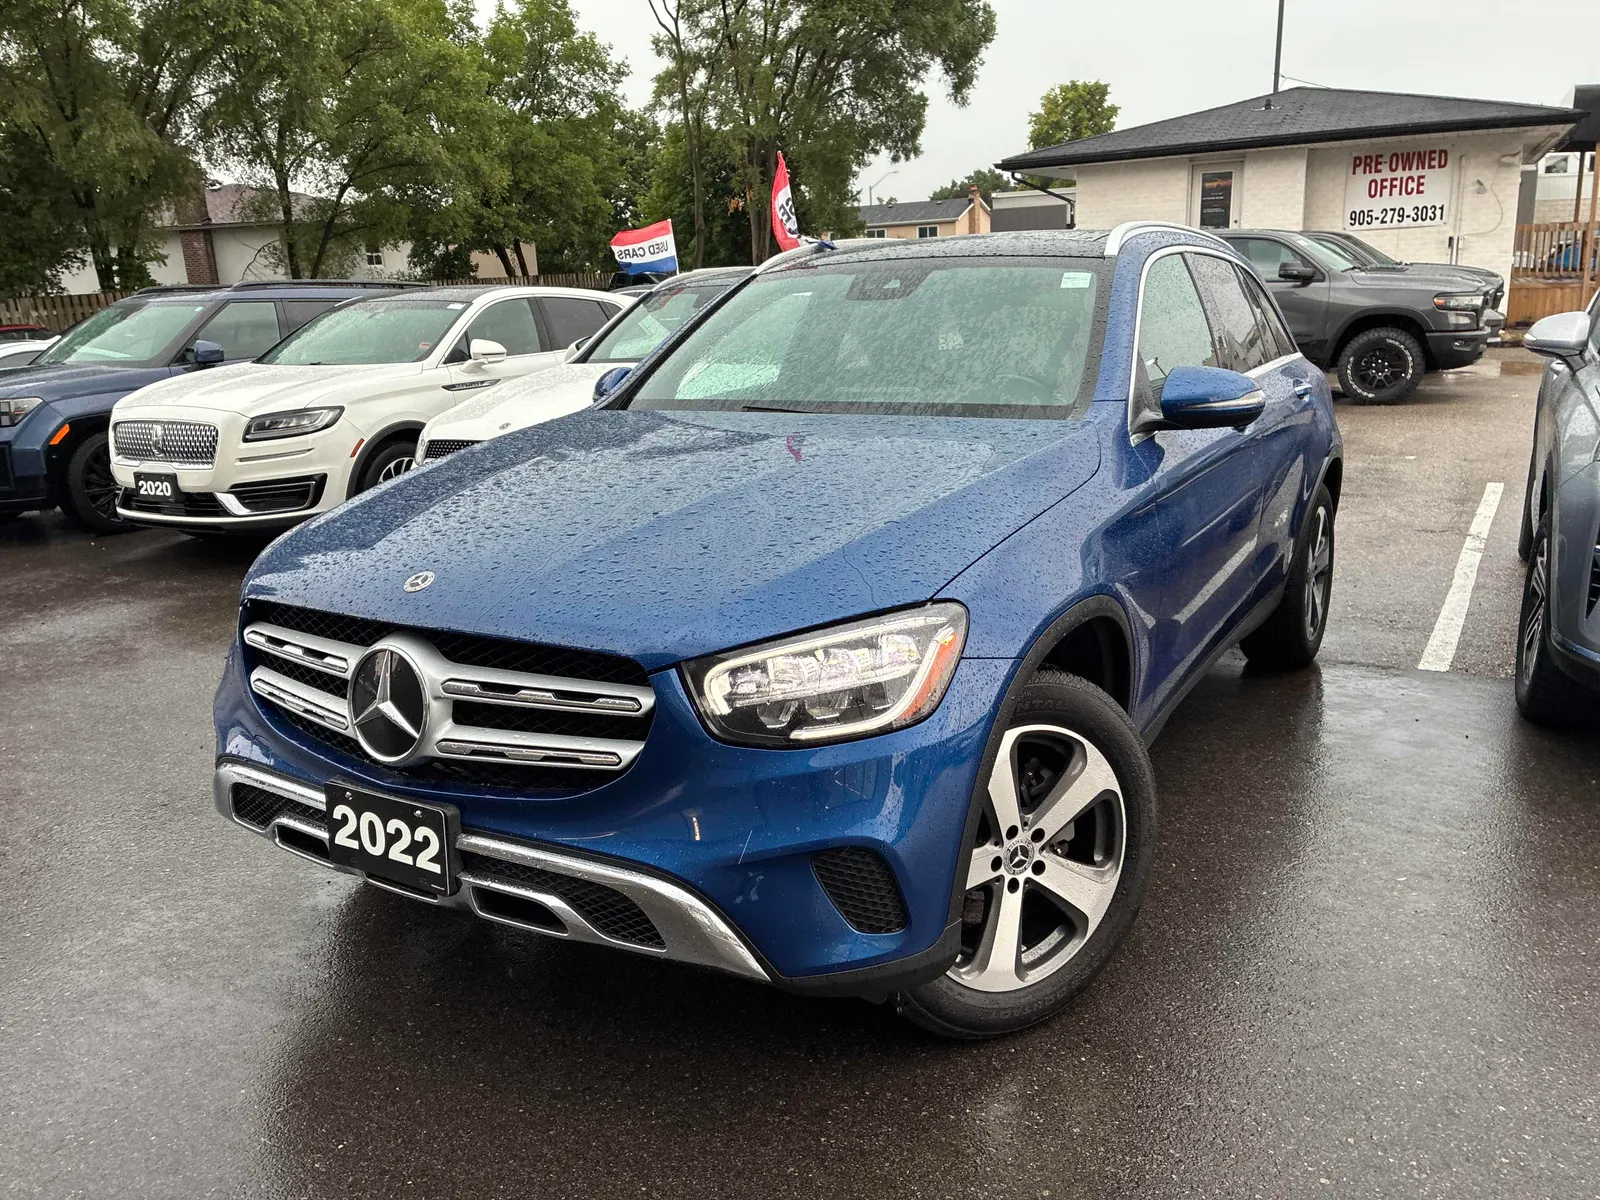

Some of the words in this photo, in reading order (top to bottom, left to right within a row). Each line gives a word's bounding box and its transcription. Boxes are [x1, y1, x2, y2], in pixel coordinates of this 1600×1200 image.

[1352, 149, 1448, 175] PRE-OWNED
[1368, 175, 1426, 199] OFFICE
[1349, 204, 1445, 226] 905-279-3031
[138, 480, 171, 497] 2020
[332, 804, 442, 875] 2022
